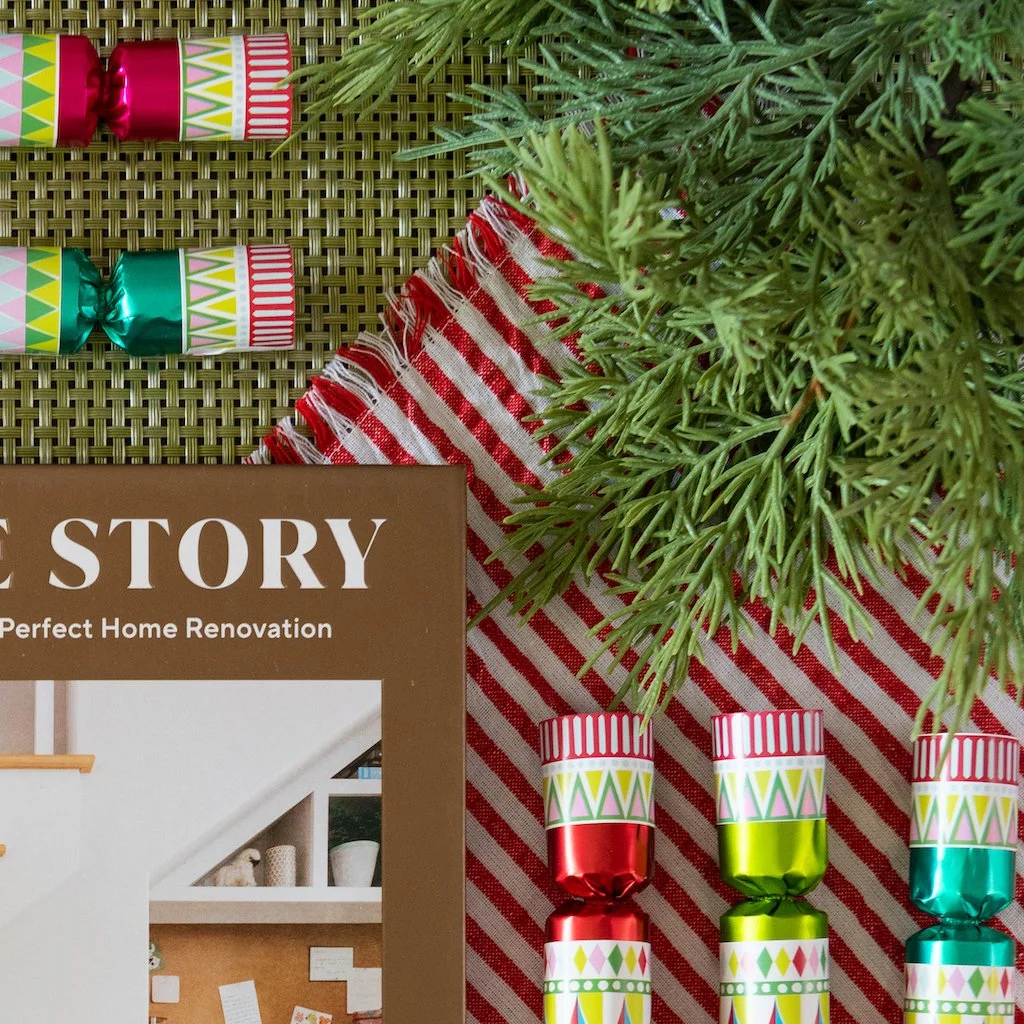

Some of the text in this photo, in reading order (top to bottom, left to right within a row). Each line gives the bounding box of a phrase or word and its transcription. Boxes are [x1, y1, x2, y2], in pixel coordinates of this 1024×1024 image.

[48, 517, 387, 590] STORY
[0, 617, 93, 639] Perfect
[101, 617, 178, 639] Home
[186, 617, 332, 639] Renovation
